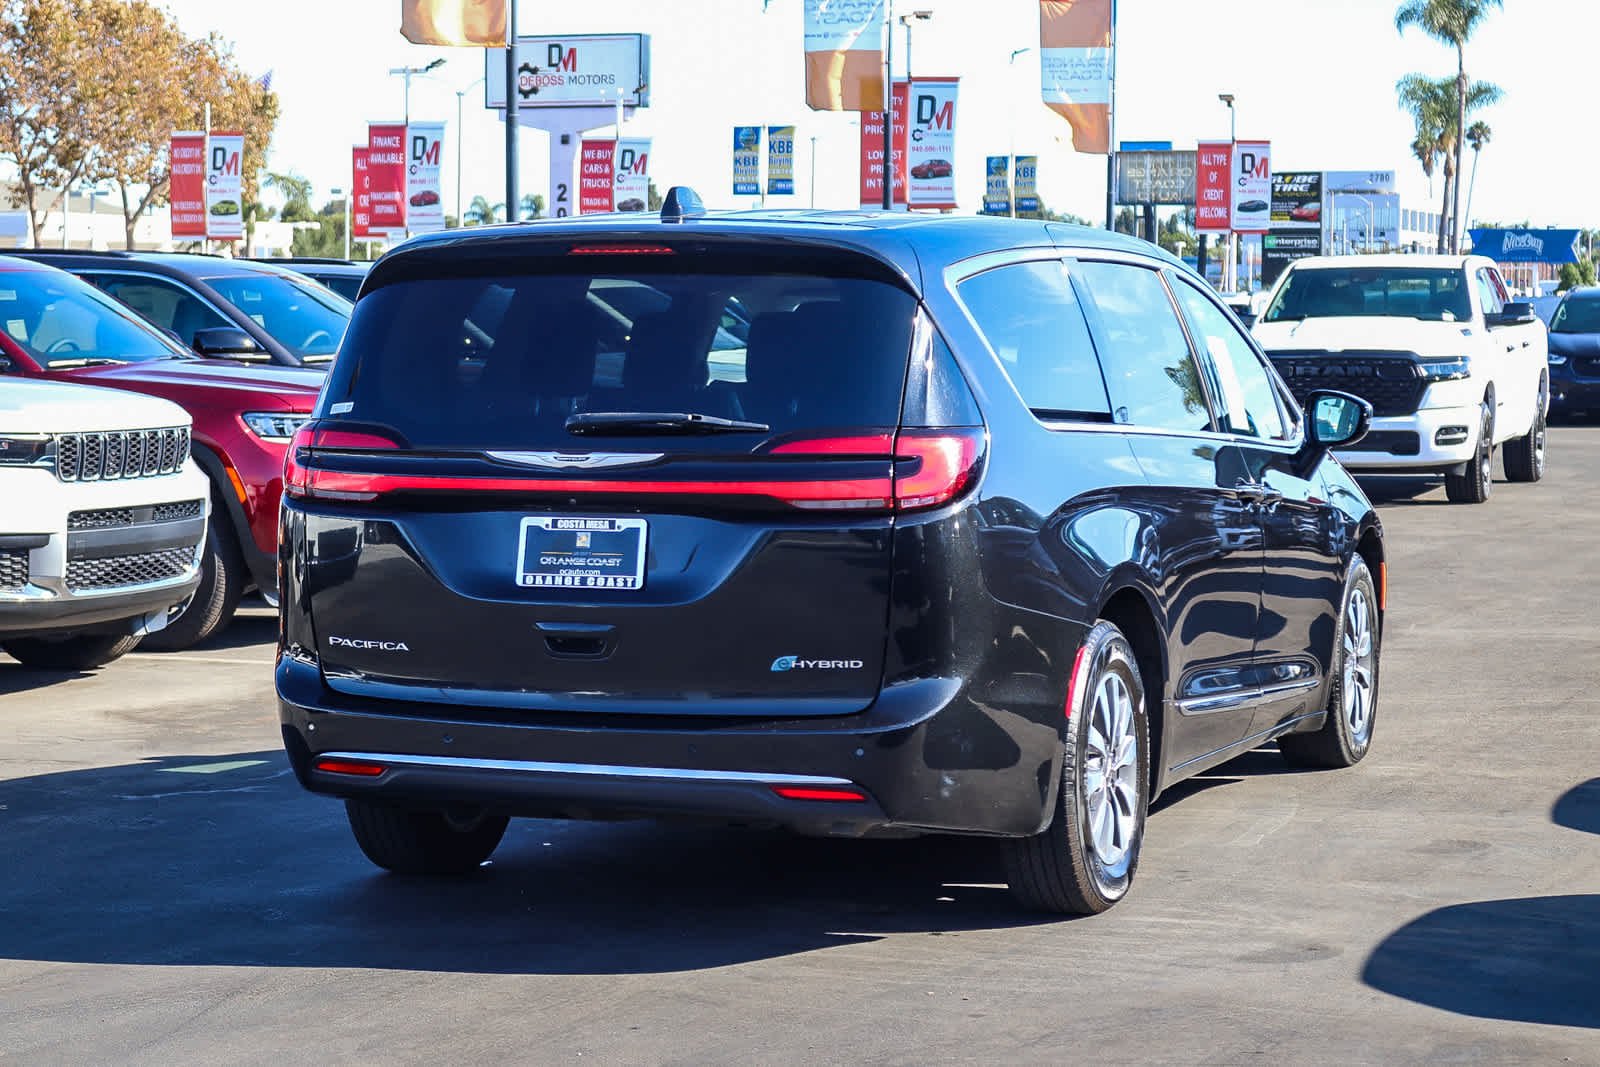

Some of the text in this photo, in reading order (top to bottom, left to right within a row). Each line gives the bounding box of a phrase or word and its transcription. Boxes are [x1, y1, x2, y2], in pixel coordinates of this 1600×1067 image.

[520, 74, 616, 87] DEBOSS MOTORS
[373, 136, 401, 147] FINANCE
[370, 153, 404, 164] AVAILABLE
[584, 150, 612, 159] WE BUY
[1201, 154, 1228, 165] ALL TYPE
[584, 164, 603, 174] CARS
[583, 178, 611, 188] TRUCKS
[1209, 172, 1218, 183] OF
[1274, 184, 1311, 192] TIRE
[1203, 189, 1224, 200] CREDIT
[1199, 207, 1228, 218] WELCOME
[557, 519, 610, 529] COSTA MESA
[540, 556, 622, 566] ORANGE COAST
[560, 568, 600, 576] ocauto.com
[525, 575, 634, 588] ORANGE COAST
[328, 636, 409, 651] PACIFICA
